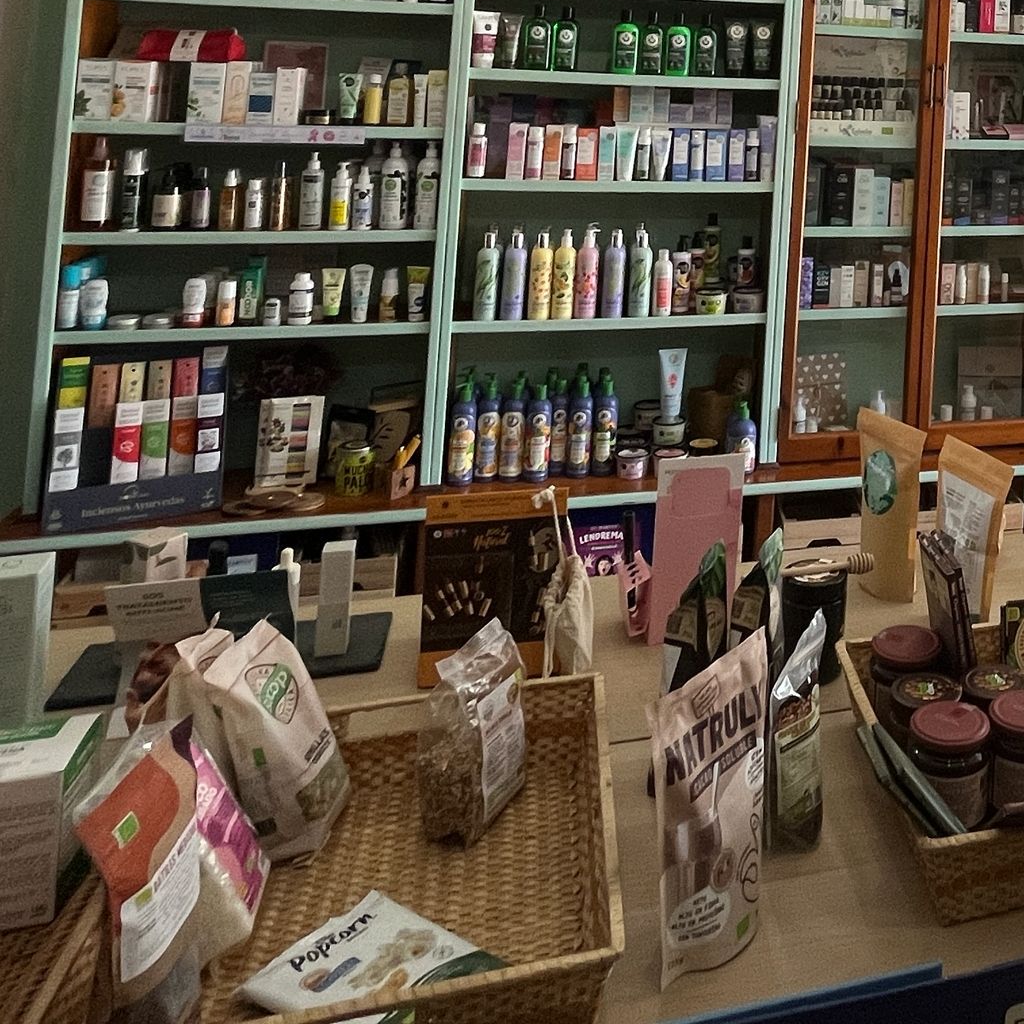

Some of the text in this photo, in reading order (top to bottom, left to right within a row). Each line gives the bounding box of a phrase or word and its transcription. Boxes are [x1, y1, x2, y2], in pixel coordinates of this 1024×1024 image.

[579, 531, 624, 544] LENDREMA
[664, 685, 761, 786] NATRULY
[289, 913, 374, 972] Popcorn
